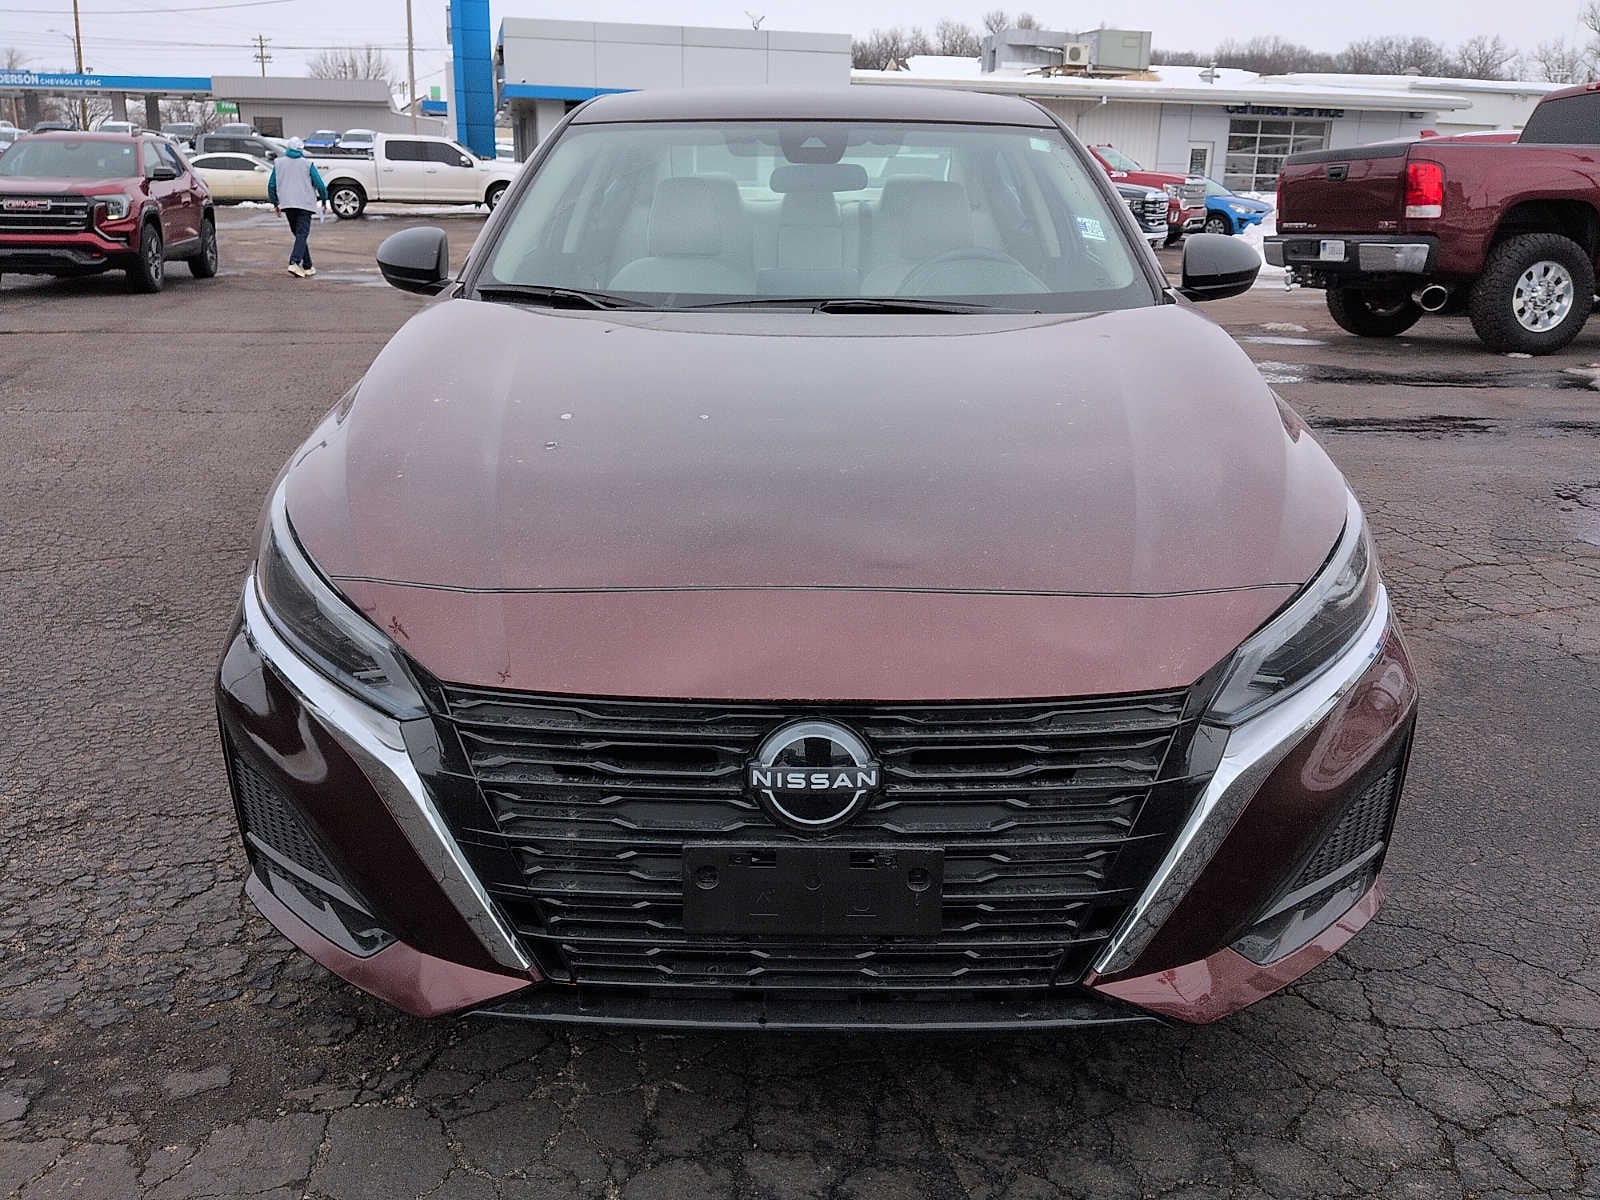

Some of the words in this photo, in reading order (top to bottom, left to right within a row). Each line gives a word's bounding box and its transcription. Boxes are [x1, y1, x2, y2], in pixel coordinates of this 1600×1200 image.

[40, 78, 82, 86] CHEVROLET
[85, 79, 102, 87] GMC
[752, 769, 877, 790] NISSAN
